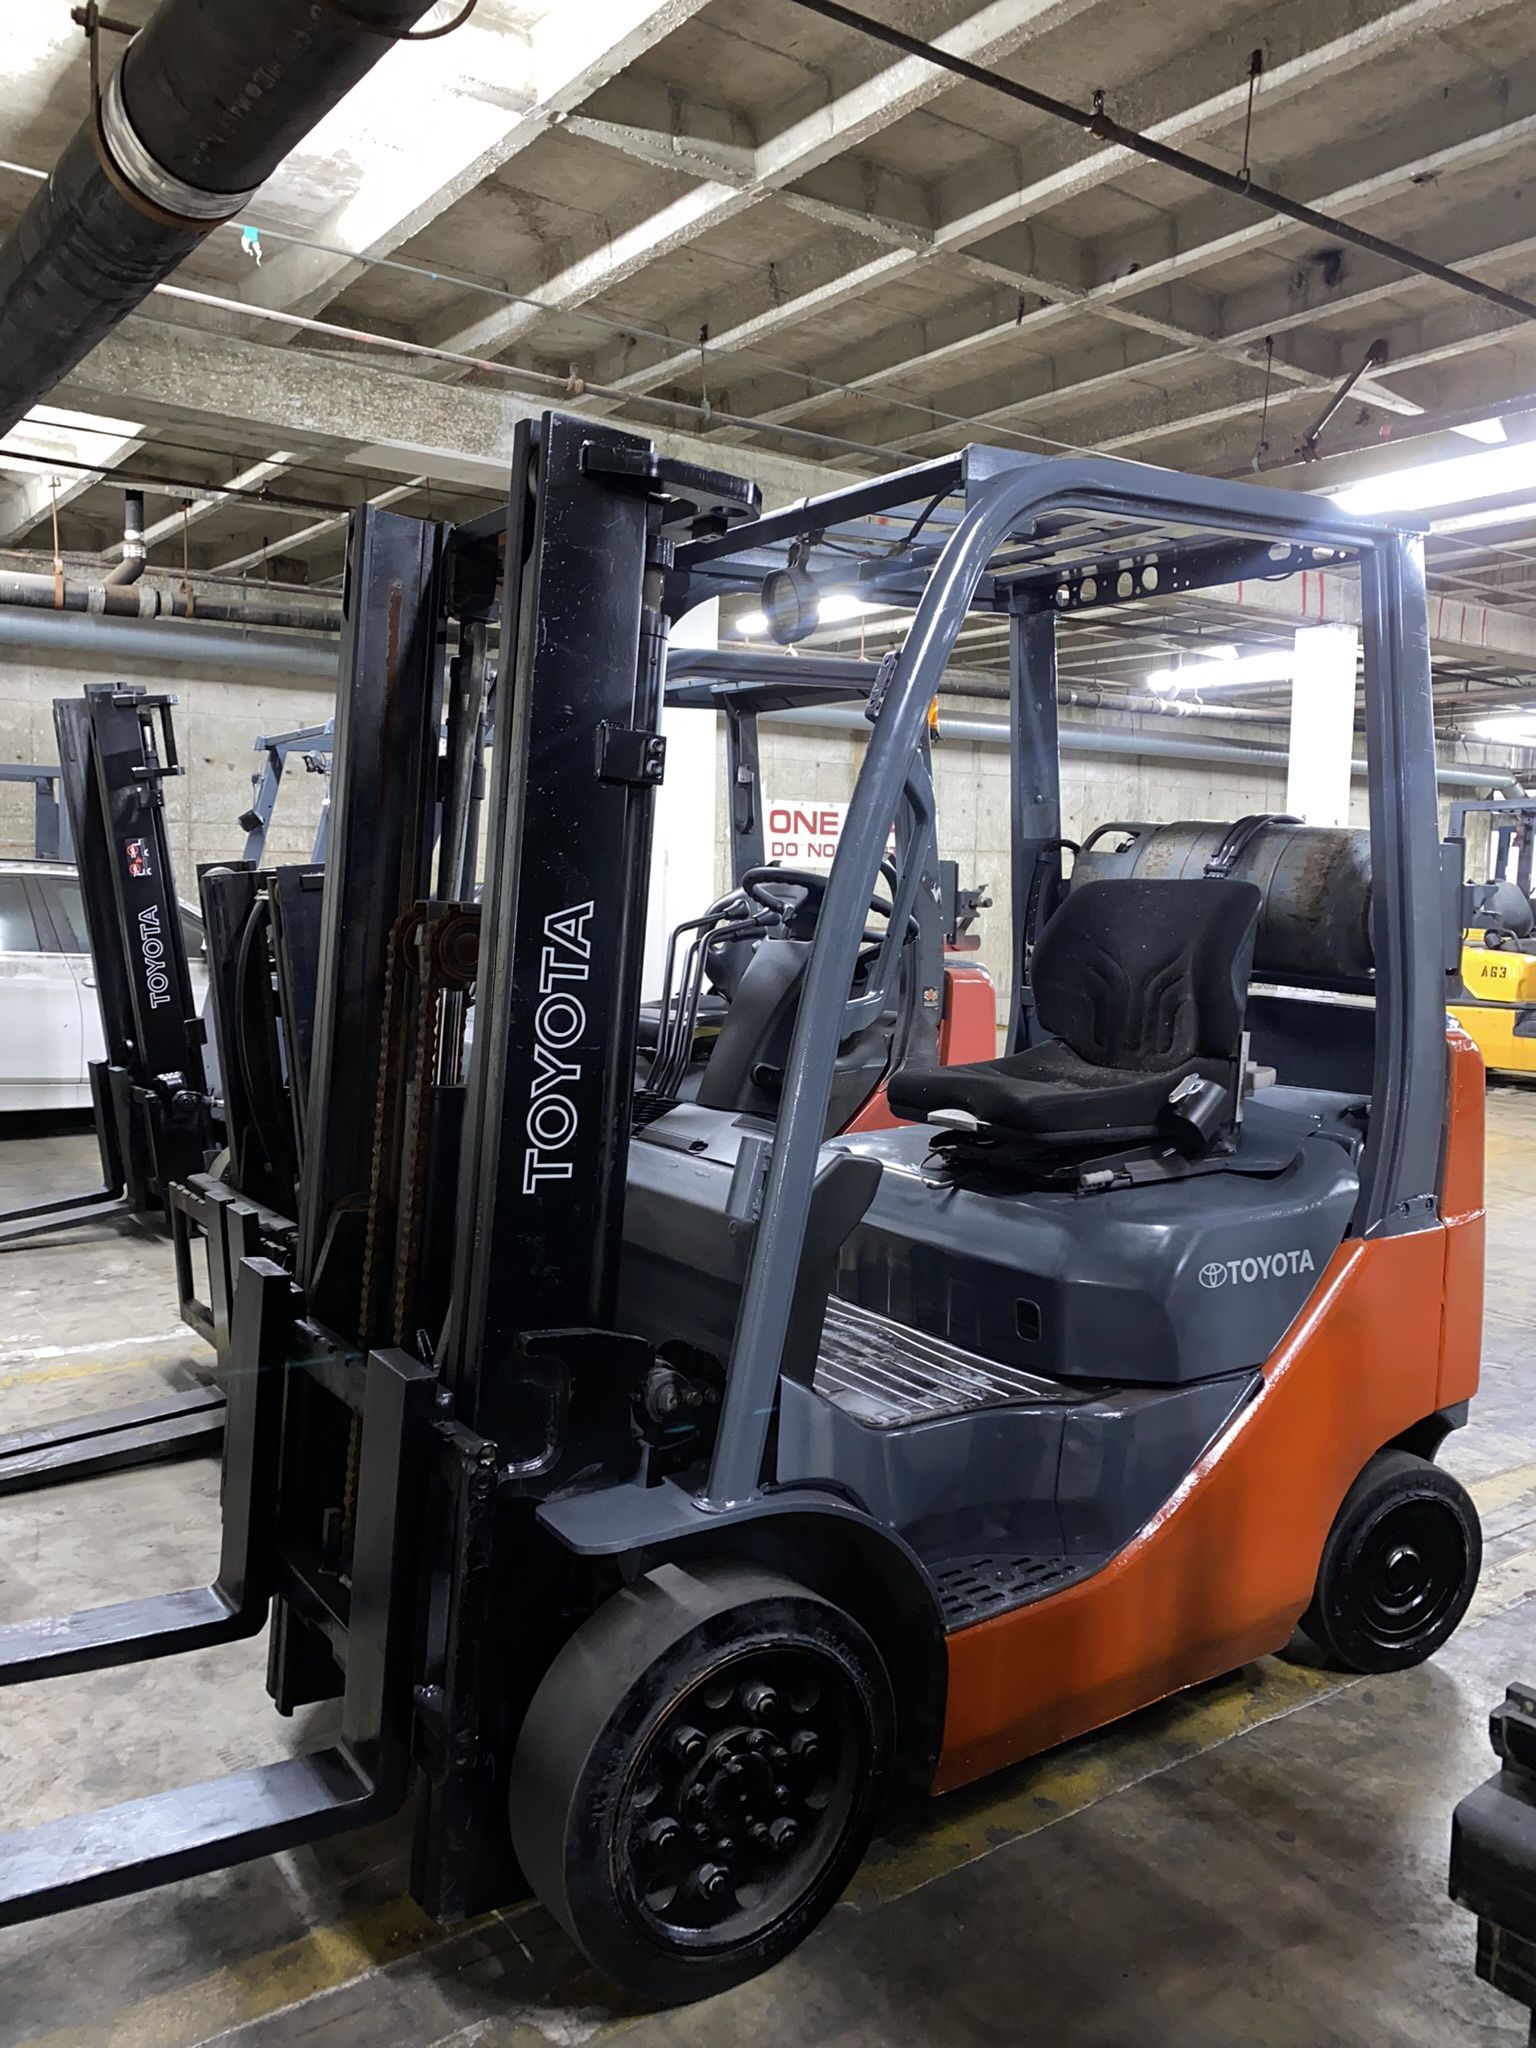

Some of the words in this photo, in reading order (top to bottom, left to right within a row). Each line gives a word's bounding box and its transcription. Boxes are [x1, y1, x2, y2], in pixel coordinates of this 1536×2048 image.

[769, 809, 839, 836] ONE
[771, 841, 798, 857] DO
[808, 843, 835, 858] NO
[138, 904, 171, 1009] TOYOTA
[522, 900, 595, 1194] TOYOTA
[1226, 1249, 1315, 1285] TOYOTA
